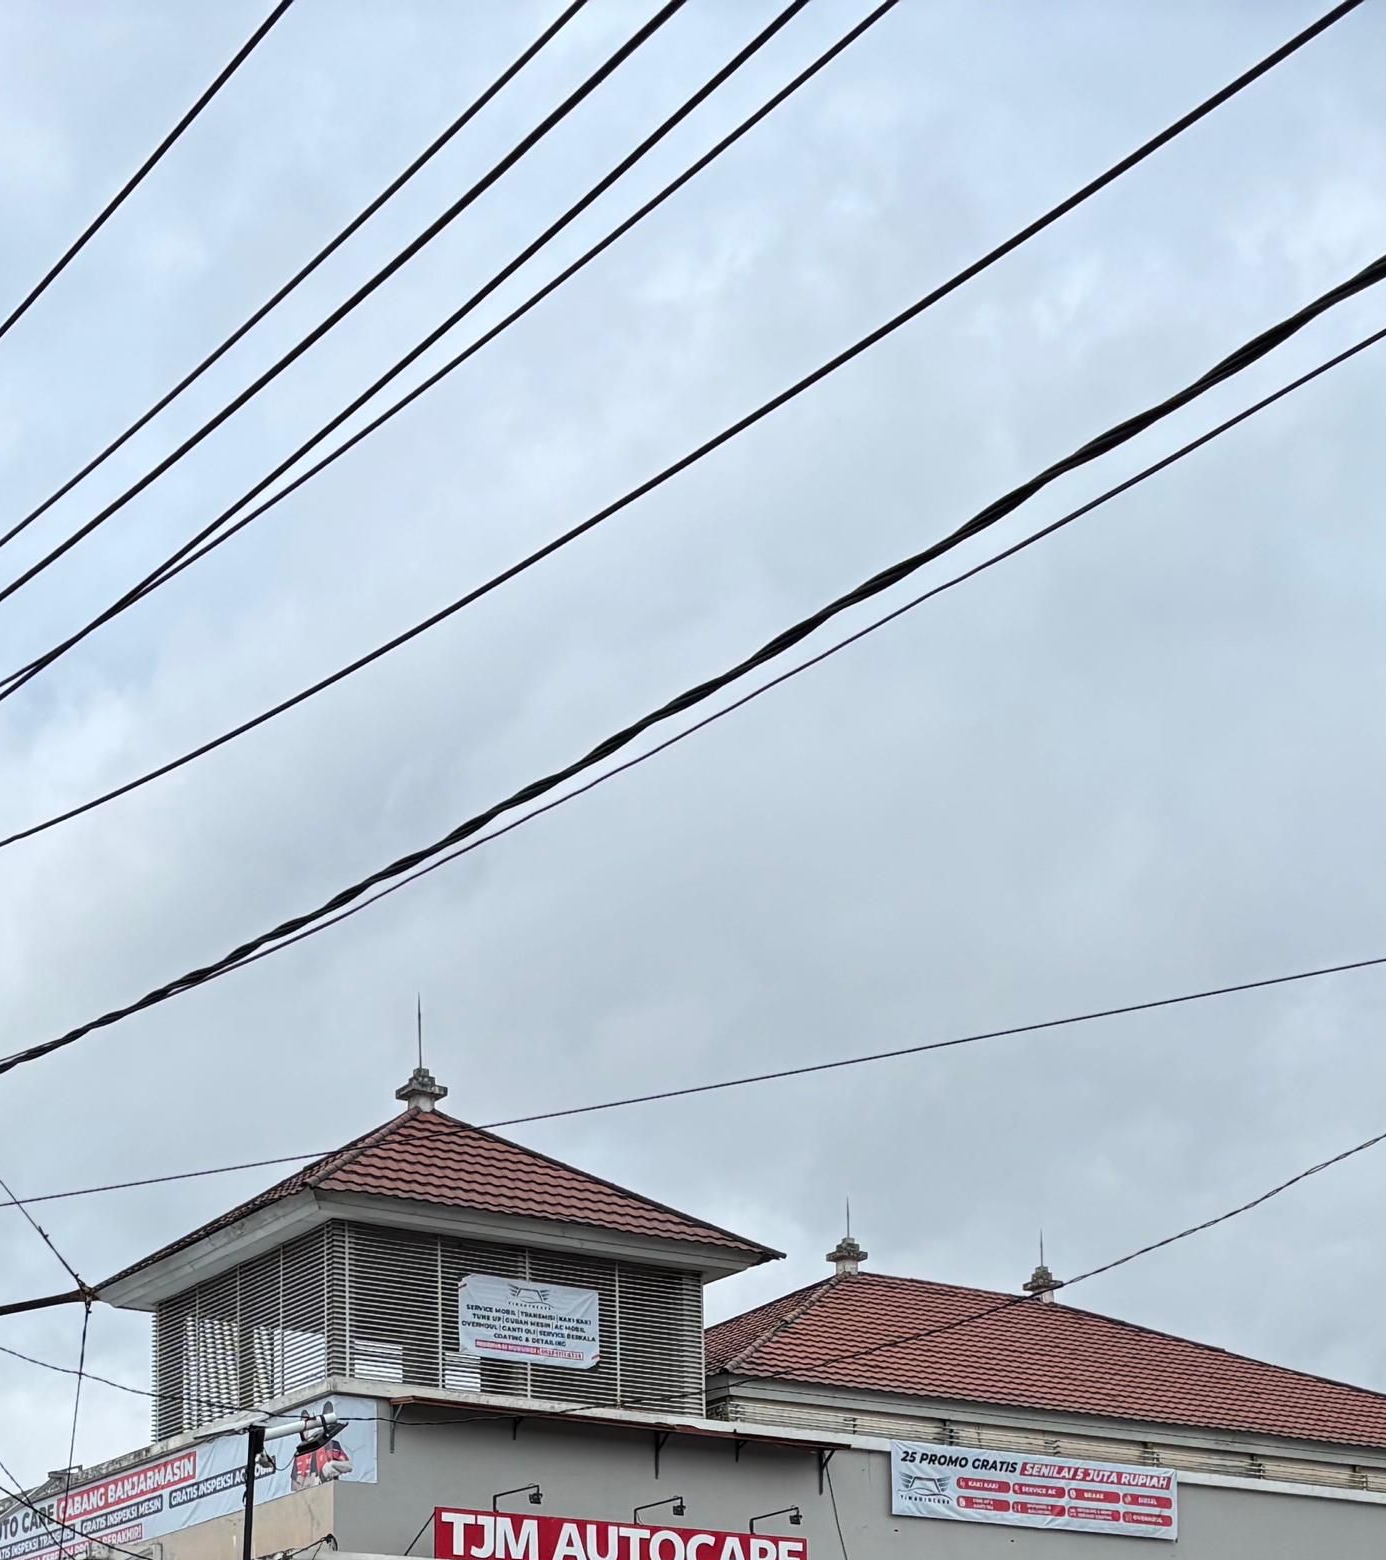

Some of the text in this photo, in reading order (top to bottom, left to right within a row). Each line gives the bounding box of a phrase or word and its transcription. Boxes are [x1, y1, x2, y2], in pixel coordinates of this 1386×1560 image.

[59, 1492, 105, 1519] CABANG
[108, 1456, 194, 1504] BANJARMASIN
[900, 1450, 1168, 1488] 25 PROMO GRATIS SENILAI 5 JUTA RUPIAH
[170, 1488, 197, 1505] GRATIS
[198, 1477, 232, 1497] INSPEKSI
